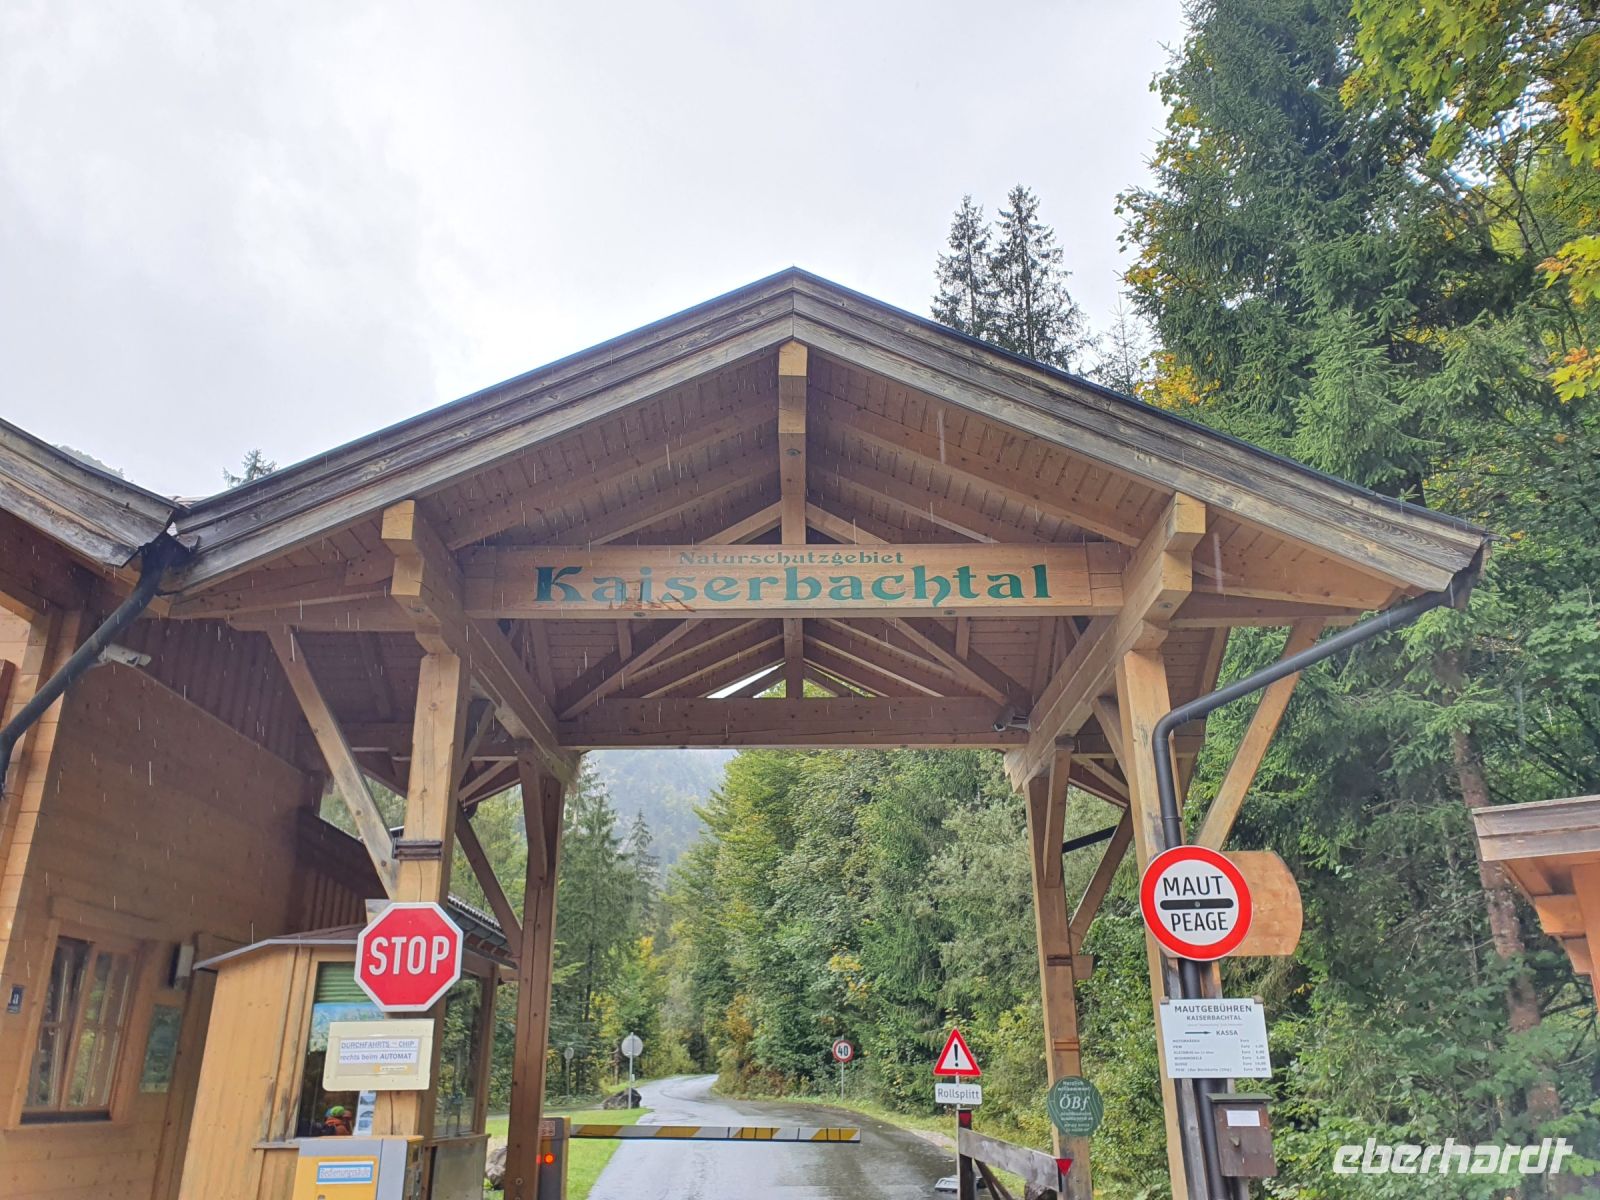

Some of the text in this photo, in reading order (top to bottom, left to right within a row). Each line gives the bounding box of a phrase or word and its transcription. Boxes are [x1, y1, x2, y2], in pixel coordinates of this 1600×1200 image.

[679, 551, 904, 566] Naturschutzgebiet
[534, 564, 1052, 608] Kaiserbachtal
[1162, 875, 1223, 897] MAUT
[1170, 911, 1229, 932] PEAGE
[368, 935, 450, 976] STOP
[1174, 1004, 1252, 1014] MAUTGEBÜHREN
[341, 1040, 390, 1049] DURCHFAHRTS
[398, 1040, 415, 1048] CHIP
[837, 1044, 849, 1057] 40
[937, 1088, 979, 1101] Rollsplitt
[1060, 1093, 1091, 1111] ÖBf
